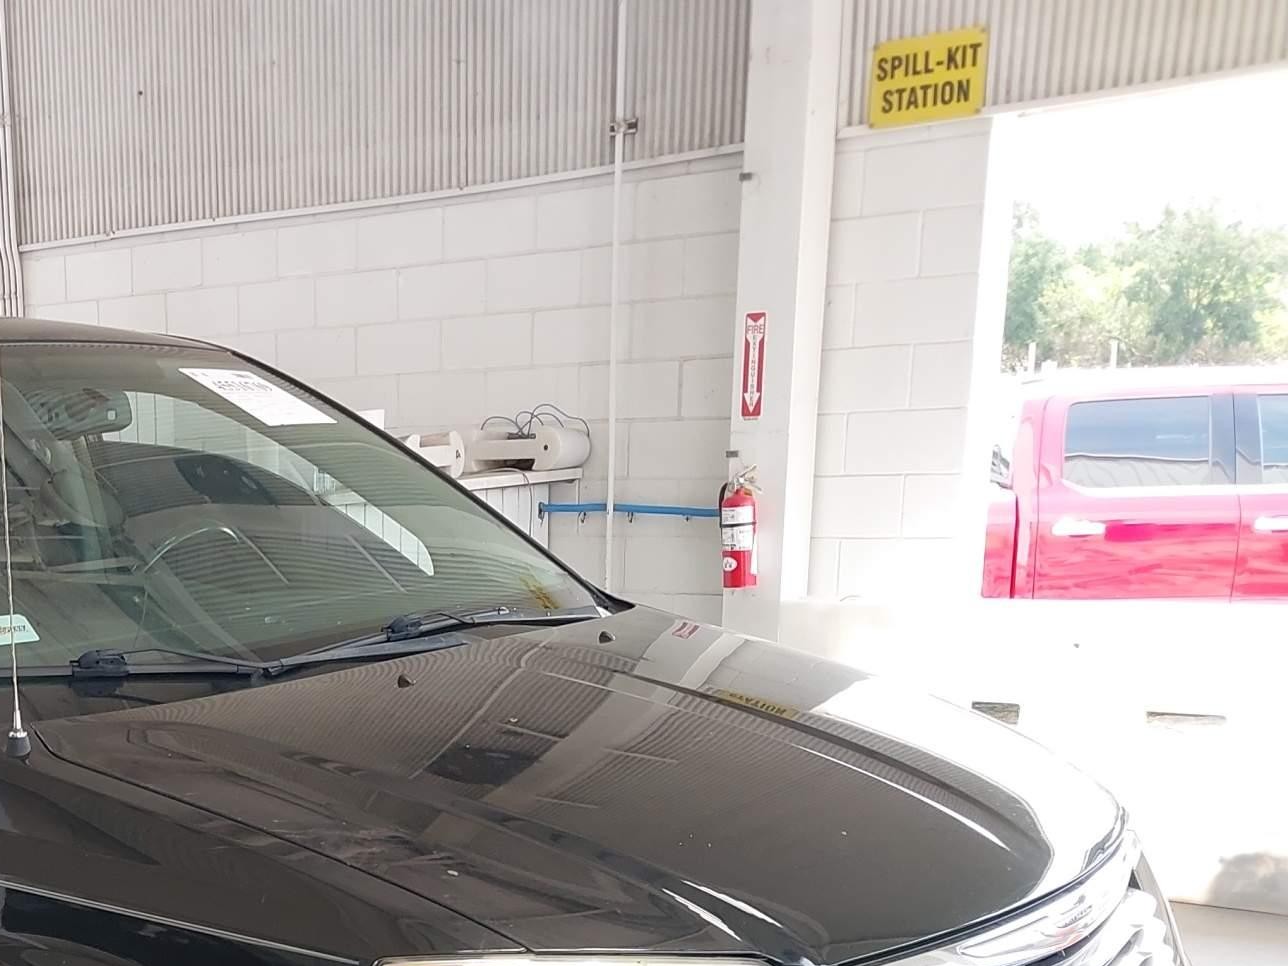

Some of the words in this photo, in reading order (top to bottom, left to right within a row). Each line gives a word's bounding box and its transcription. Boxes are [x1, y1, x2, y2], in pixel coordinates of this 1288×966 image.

[876, 42, 982, 82] SPILL-KIT
[881, 78, 971, 114] STATION
[747, 324, 764, 335] FIRE
